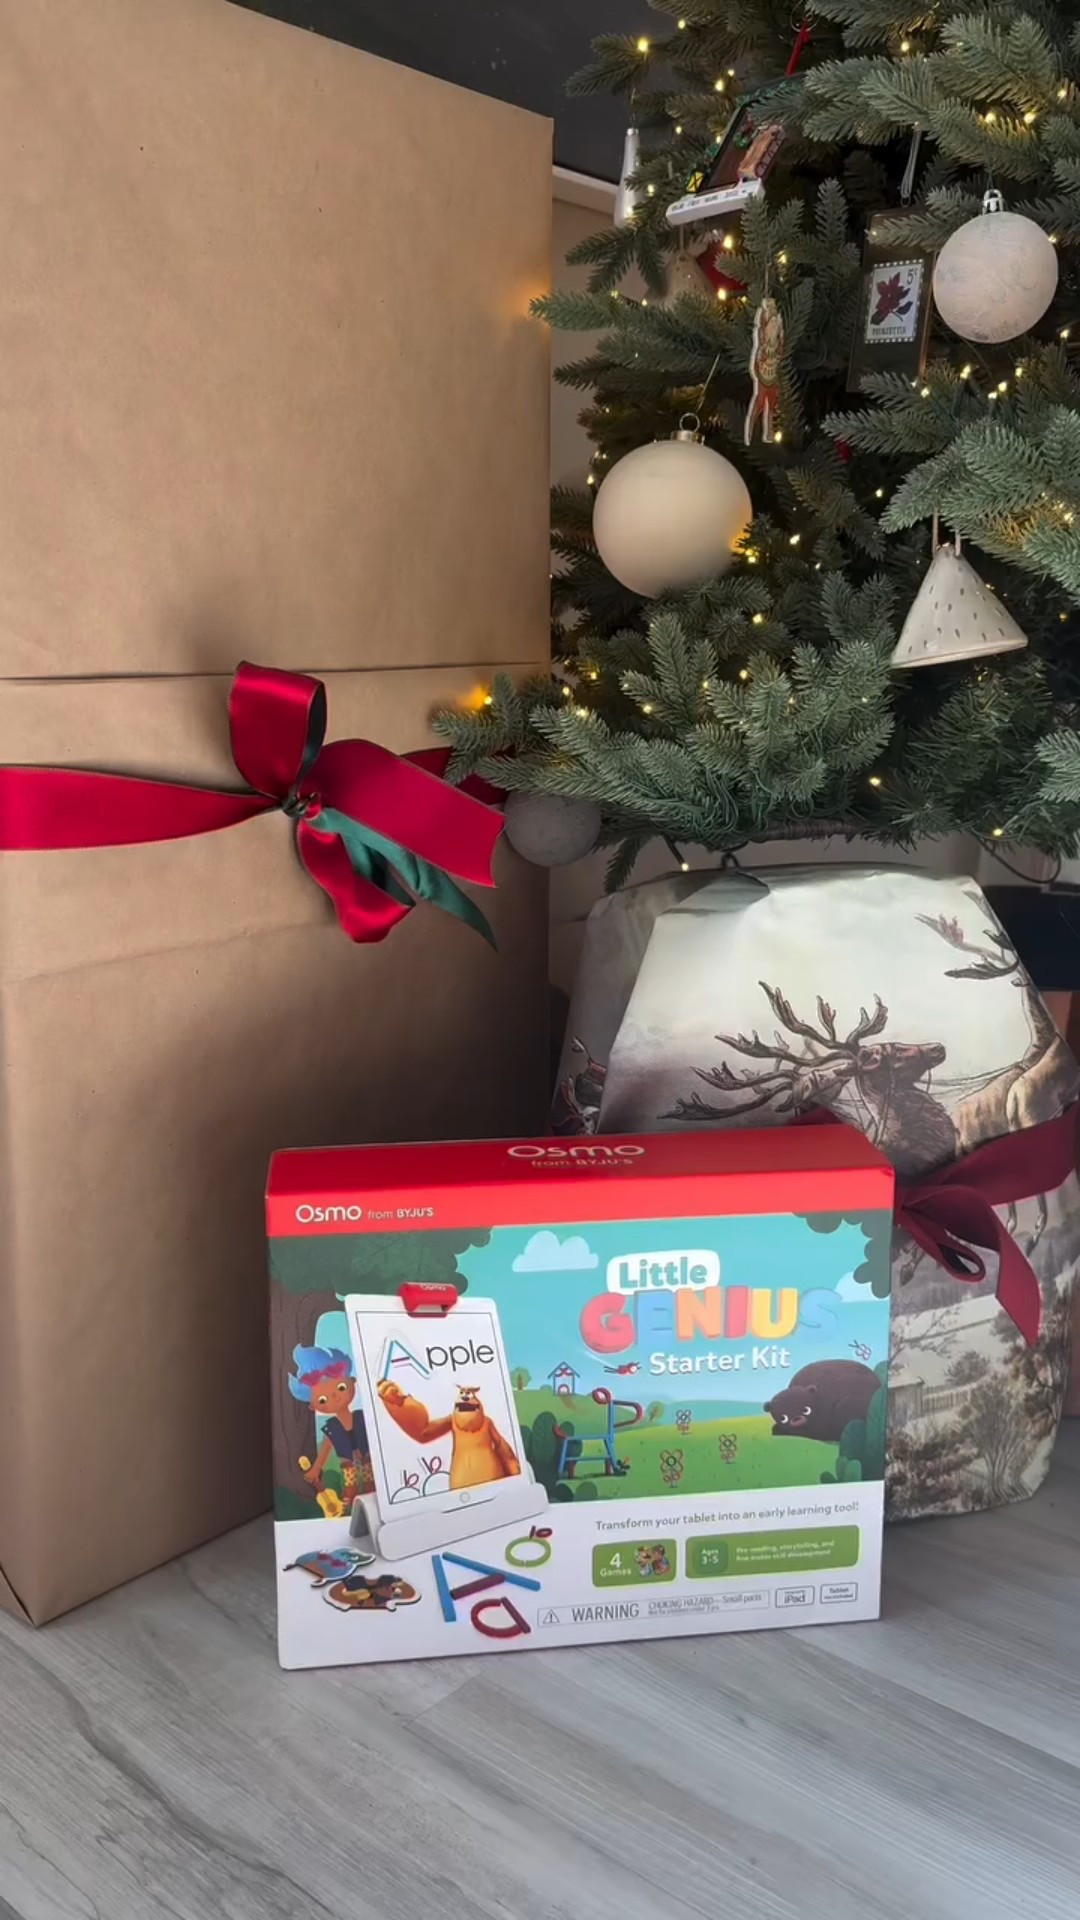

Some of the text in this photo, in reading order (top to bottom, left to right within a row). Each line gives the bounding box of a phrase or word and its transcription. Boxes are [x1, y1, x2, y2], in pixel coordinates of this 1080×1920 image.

[507, 1145, 645, 1157] Osmo
[296, 1204, 434, 1223] Osmo from BYJU'S
[619, 1256, 708, 1289] Little
[579, 1285, 844, 1354] GENIUS
[384, 1339, 495, 1380] Apple
[649, 1345, 791, 1376] Starter Kit
[595, 1501, 859, 1530] Transform your tablet into an early learning tool!
[610, 1552, 622, 1568] 4
[701, 1548, 719, 1556] Ages
[600, 1567, 632, 1577] Games
[571, 1603, 640, 1622] WARNING
